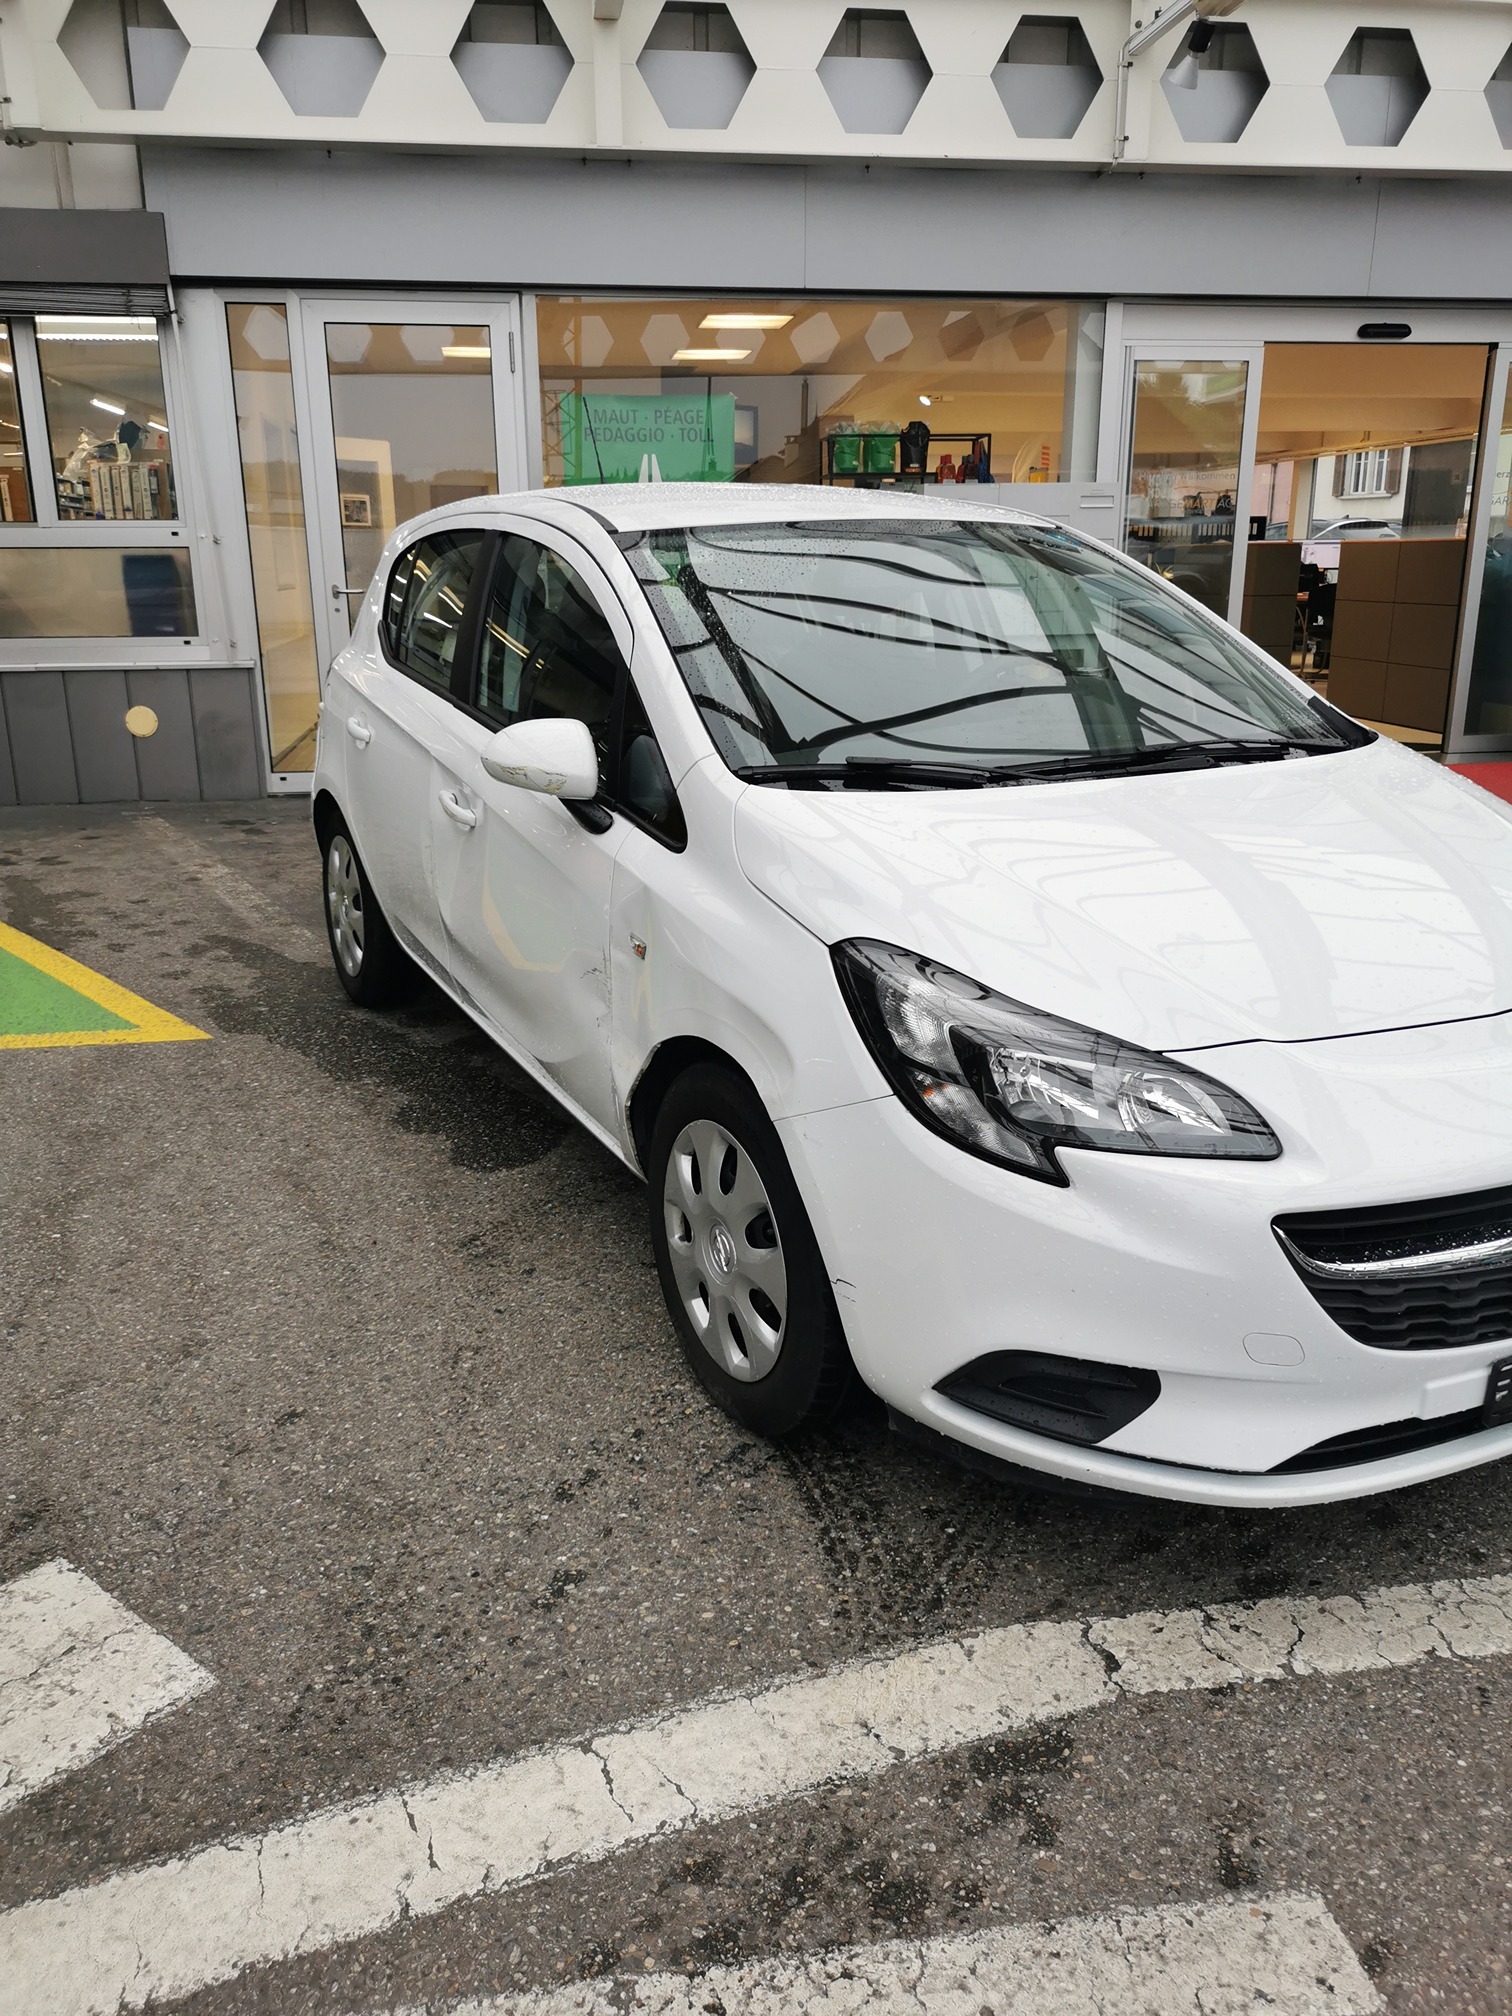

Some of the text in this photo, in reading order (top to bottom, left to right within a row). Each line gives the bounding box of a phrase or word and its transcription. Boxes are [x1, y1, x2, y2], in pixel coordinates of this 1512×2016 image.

[593, 406, 705, 425] MAUT PÉAGE
[584, 427, 714, 443] PEDAGGIO TOLL
